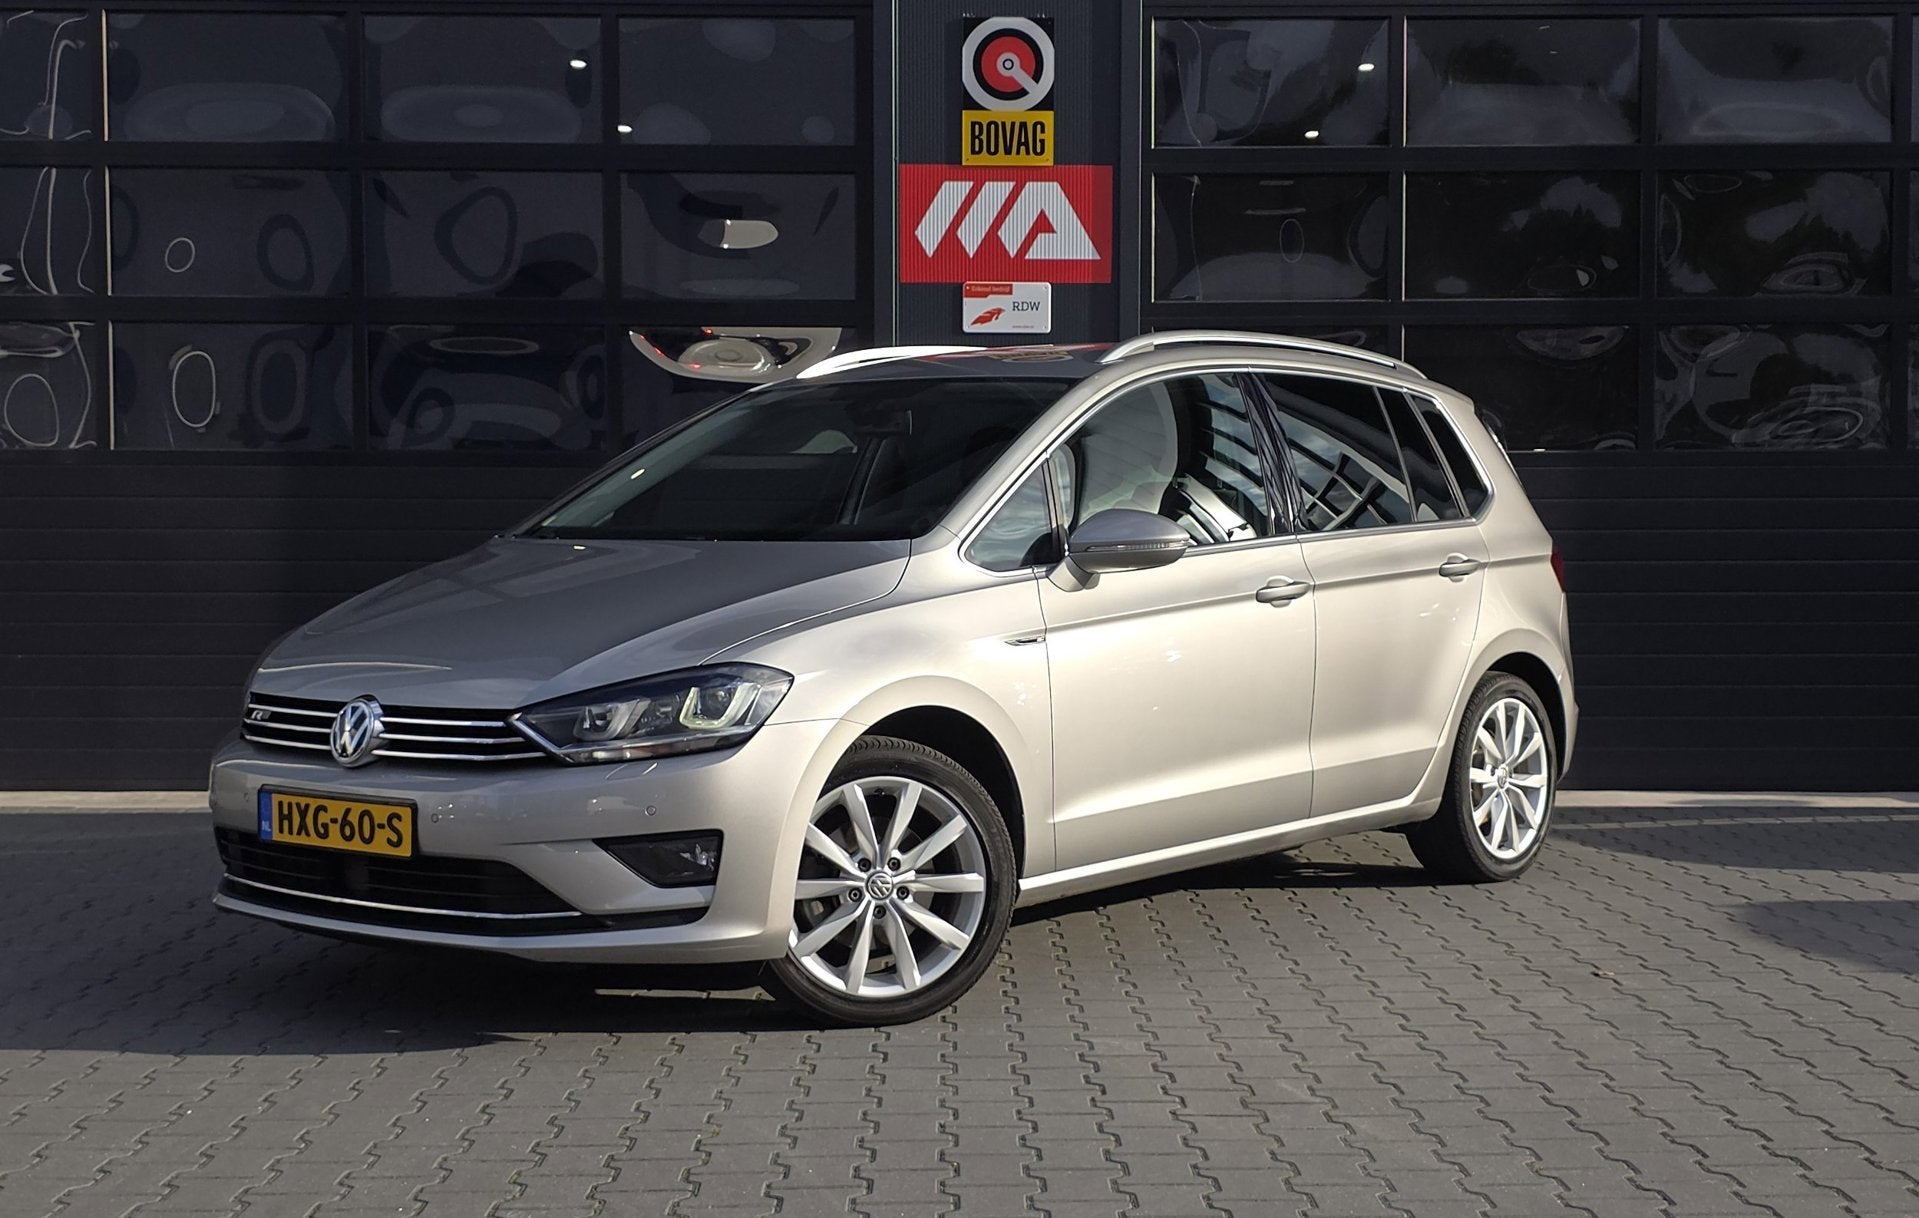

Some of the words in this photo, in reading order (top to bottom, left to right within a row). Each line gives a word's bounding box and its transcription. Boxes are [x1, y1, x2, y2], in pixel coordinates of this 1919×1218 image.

[970, 121, 1046, 156] BOVAG
[1012, 301, 1040, 312] RDW
[261, 821, 271, 831] NL
[278, 800, 403, 848] HXG-60-S
